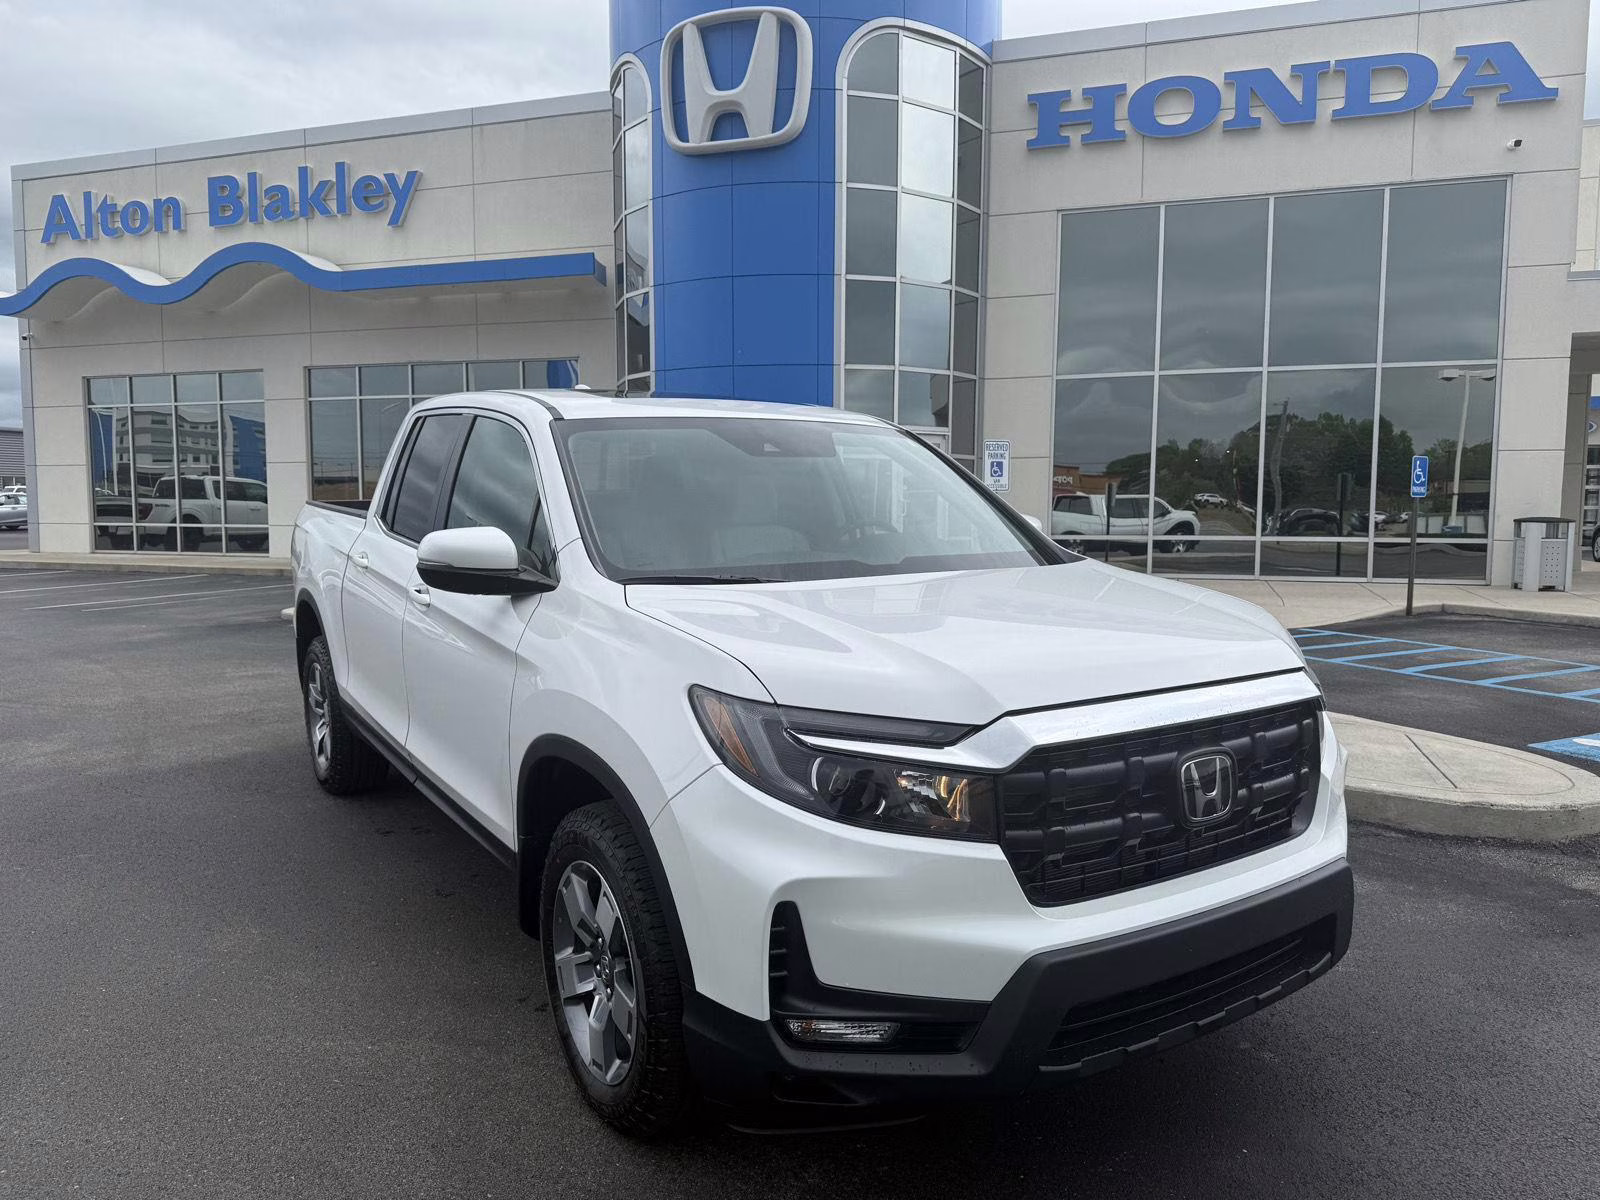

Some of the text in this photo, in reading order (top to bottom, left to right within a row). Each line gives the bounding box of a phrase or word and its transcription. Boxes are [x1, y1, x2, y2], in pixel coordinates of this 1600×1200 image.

[1026, 41, 1559, 150] HONDA
[40, 161, 421, 244] Alton Blakley
[986, 443, 1009, 451] RESERVED
[987, 452, 1007, 460] PARKING
